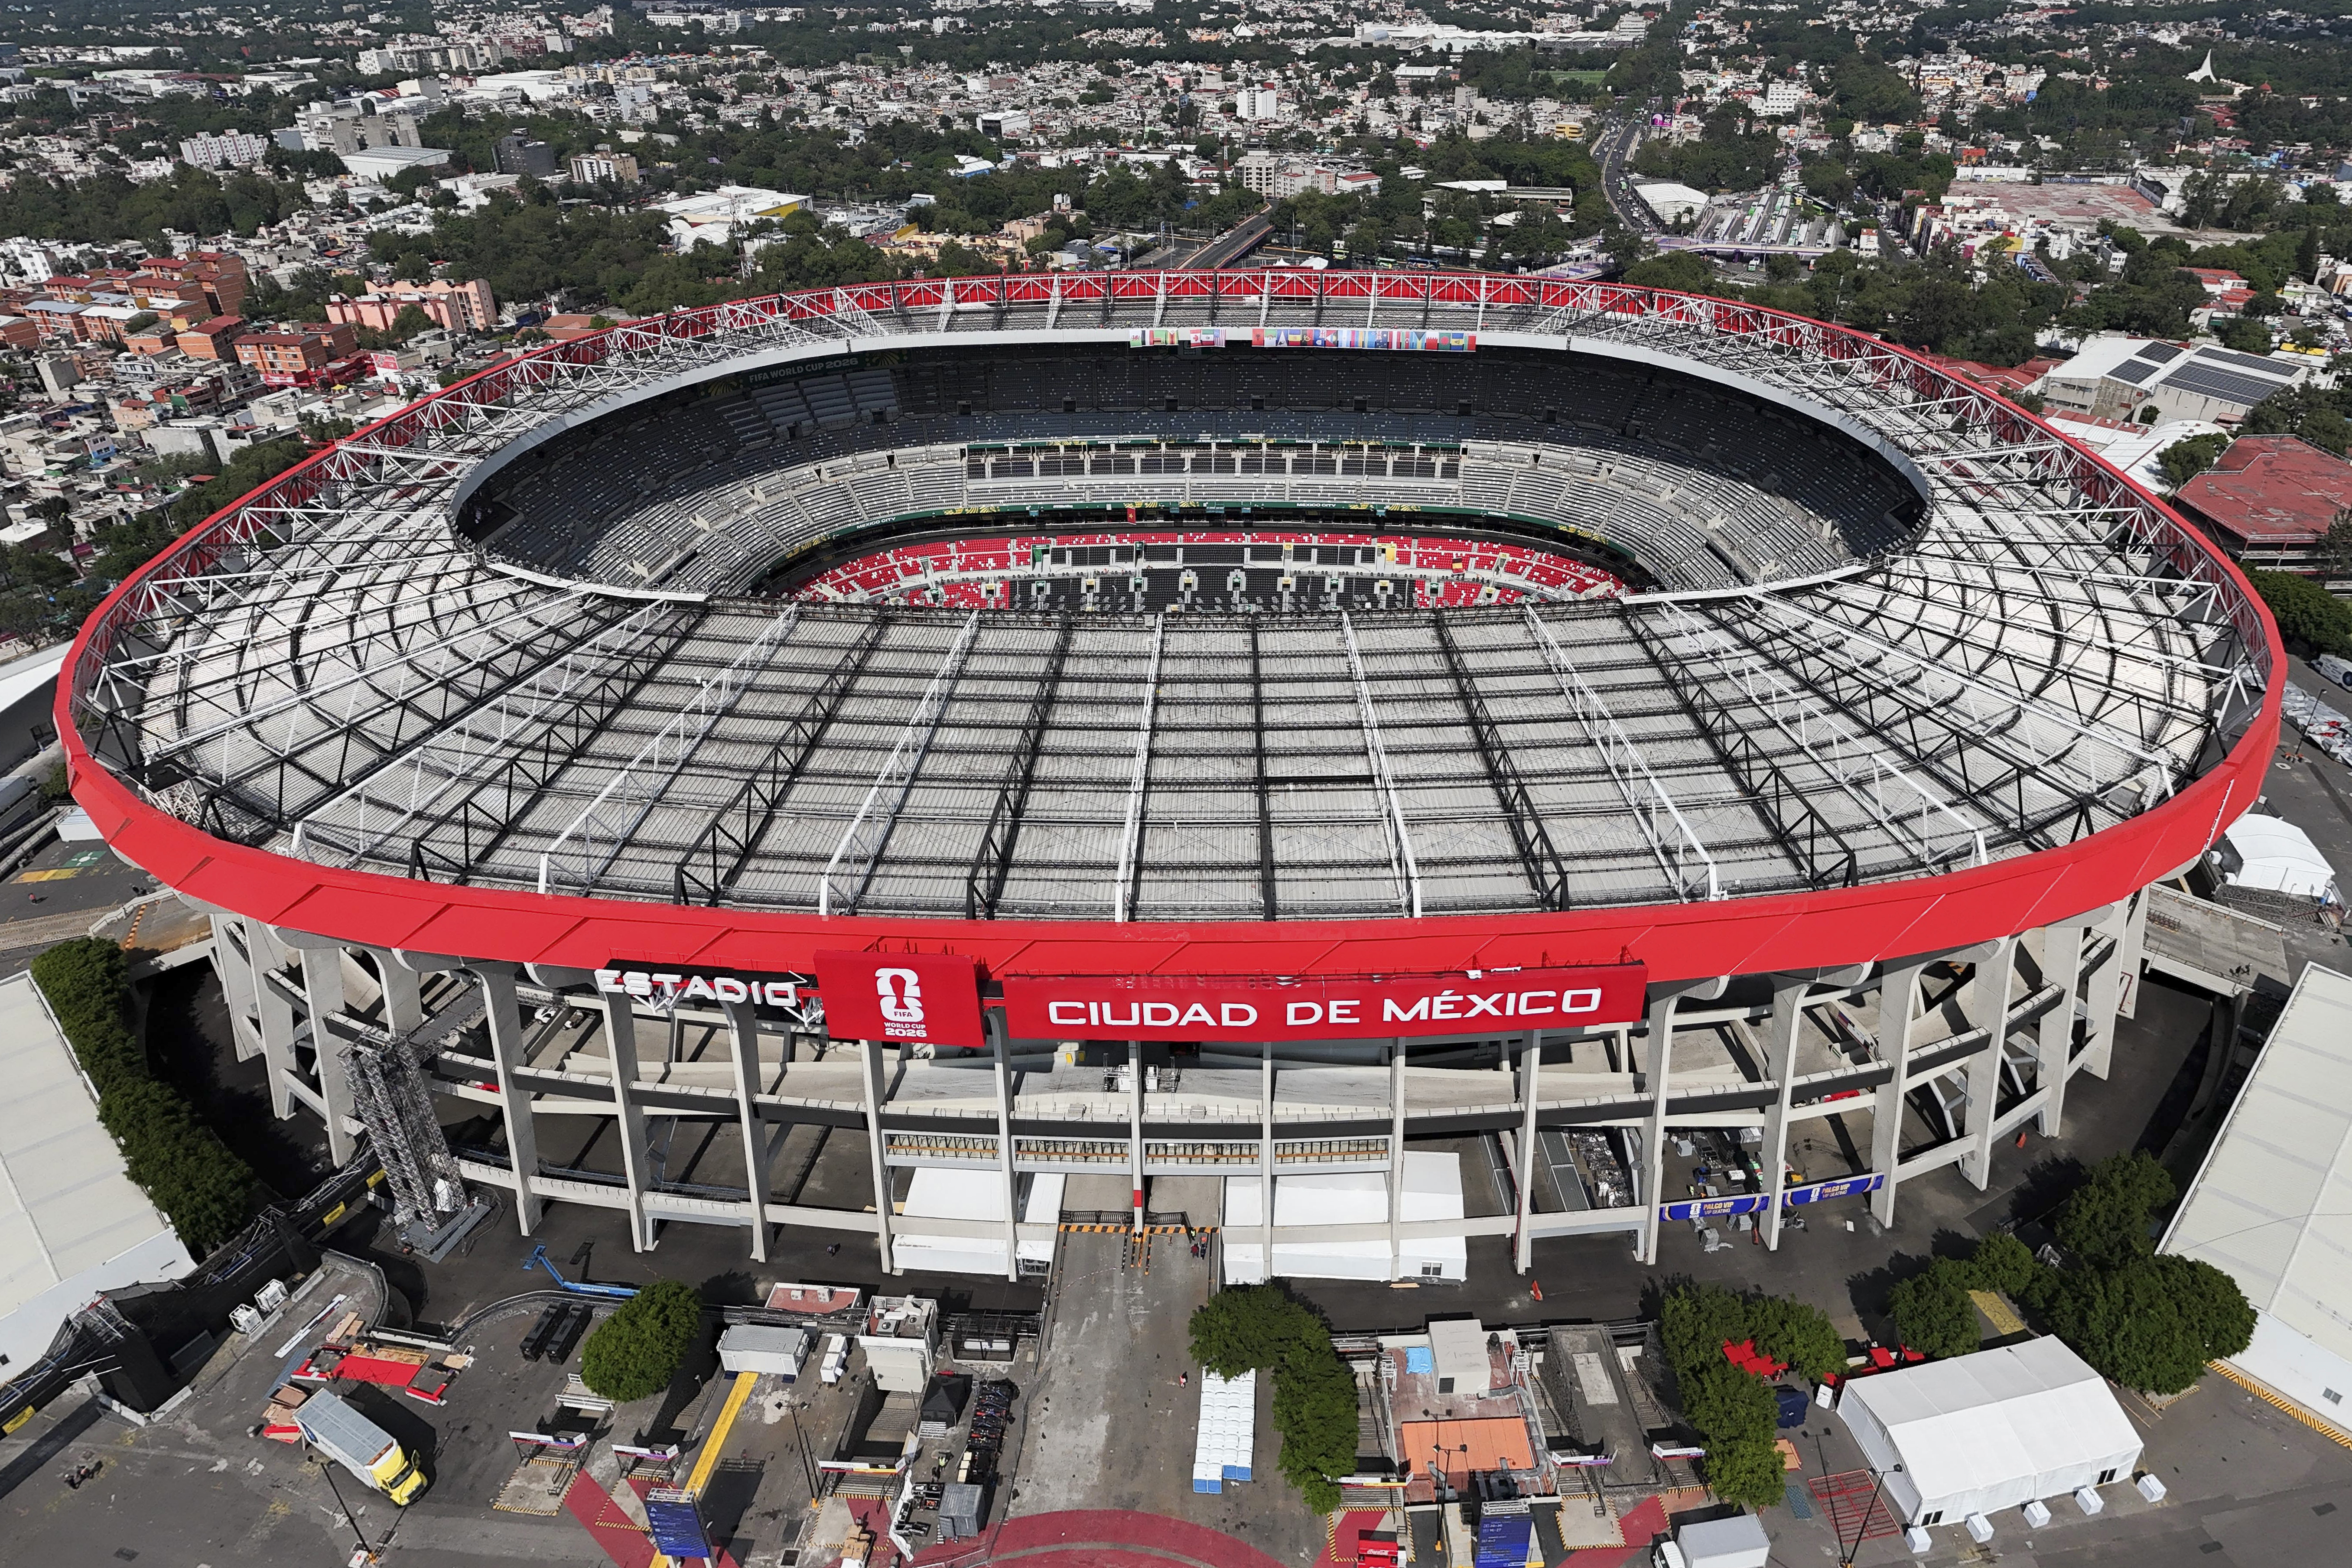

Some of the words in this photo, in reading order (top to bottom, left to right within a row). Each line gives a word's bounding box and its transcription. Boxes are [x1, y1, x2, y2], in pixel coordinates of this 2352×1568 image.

[749, 373, 769, 383] FIFA
[770, 366, 804, 378] WORLD
[805, 363, 824, 371] CUP
[826, 358, 859, 368] 2026
[856, 519, 881, 529] MEXICO
[594, 969, 797, 1007] ESTADIO
[1048, 1000, 1258, 1028] CIUDAD
[1285, 999, 1360, 1026] DE
[1382, 989, 1602, 1023] MÉXICO
[885, 1028, 927, 1038] 2026
[1822, 1185, 1840, 1194] PALCO
